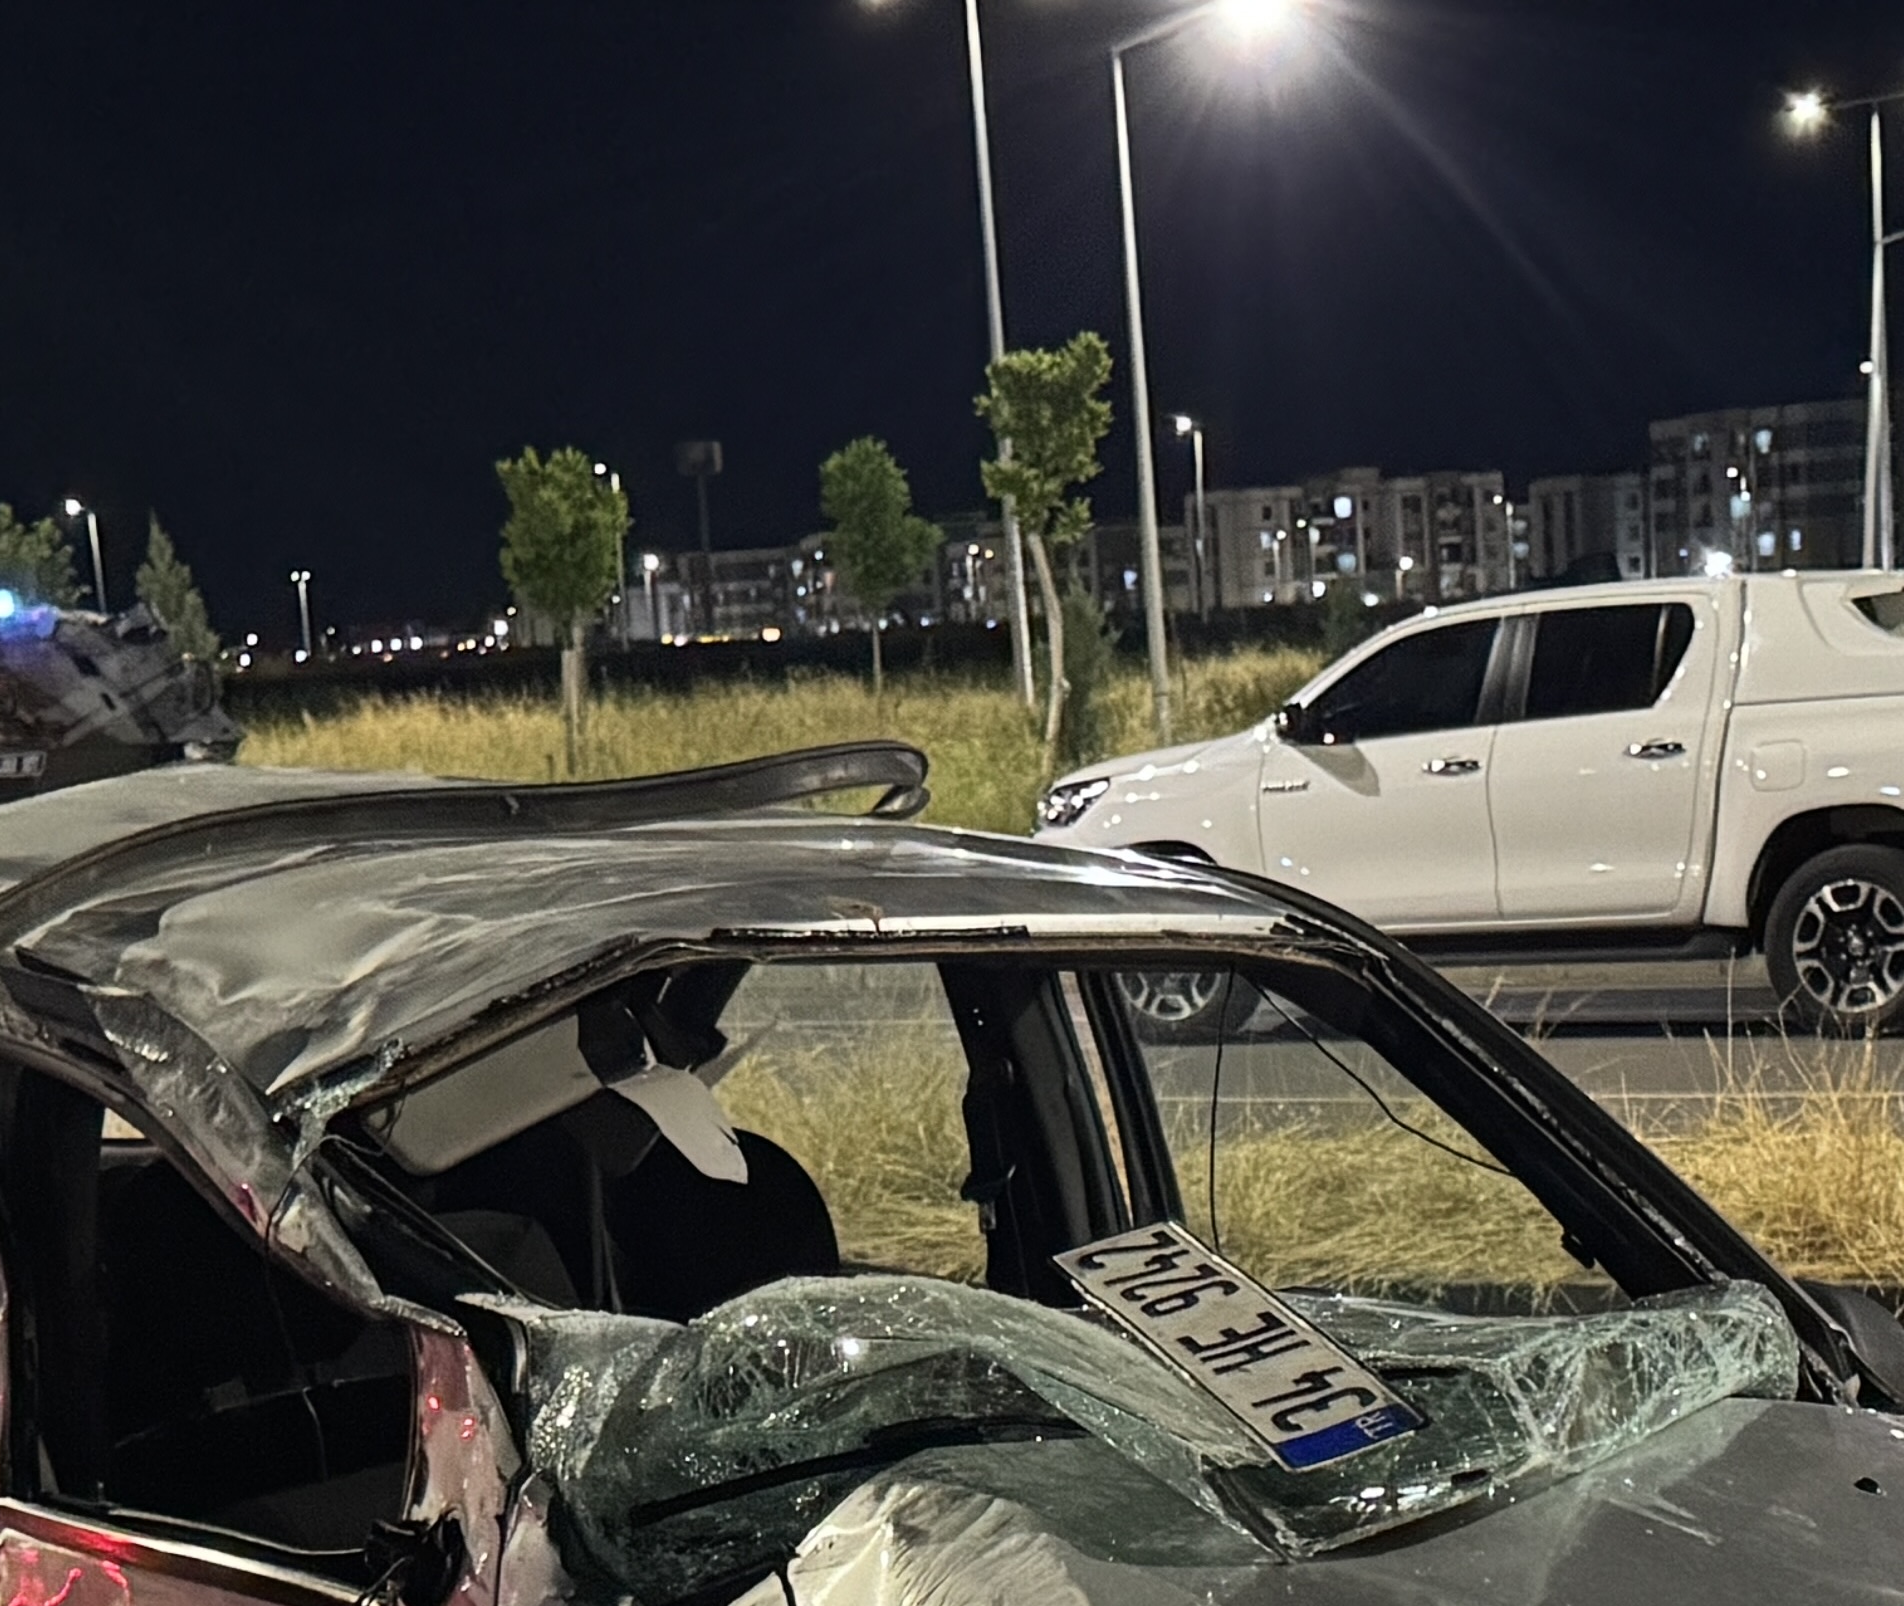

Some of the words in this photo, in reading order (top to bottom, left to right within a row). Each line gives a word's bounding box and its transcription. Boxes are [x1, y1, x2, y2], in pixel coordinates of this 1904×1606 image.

[1078, 1230, 1240, 1318] 9242
[1176, 1311, 1311, 1375] HE
[1250, 1366, 1378, 1432] 34
[1355, 1411, 1393, 1440] TR
